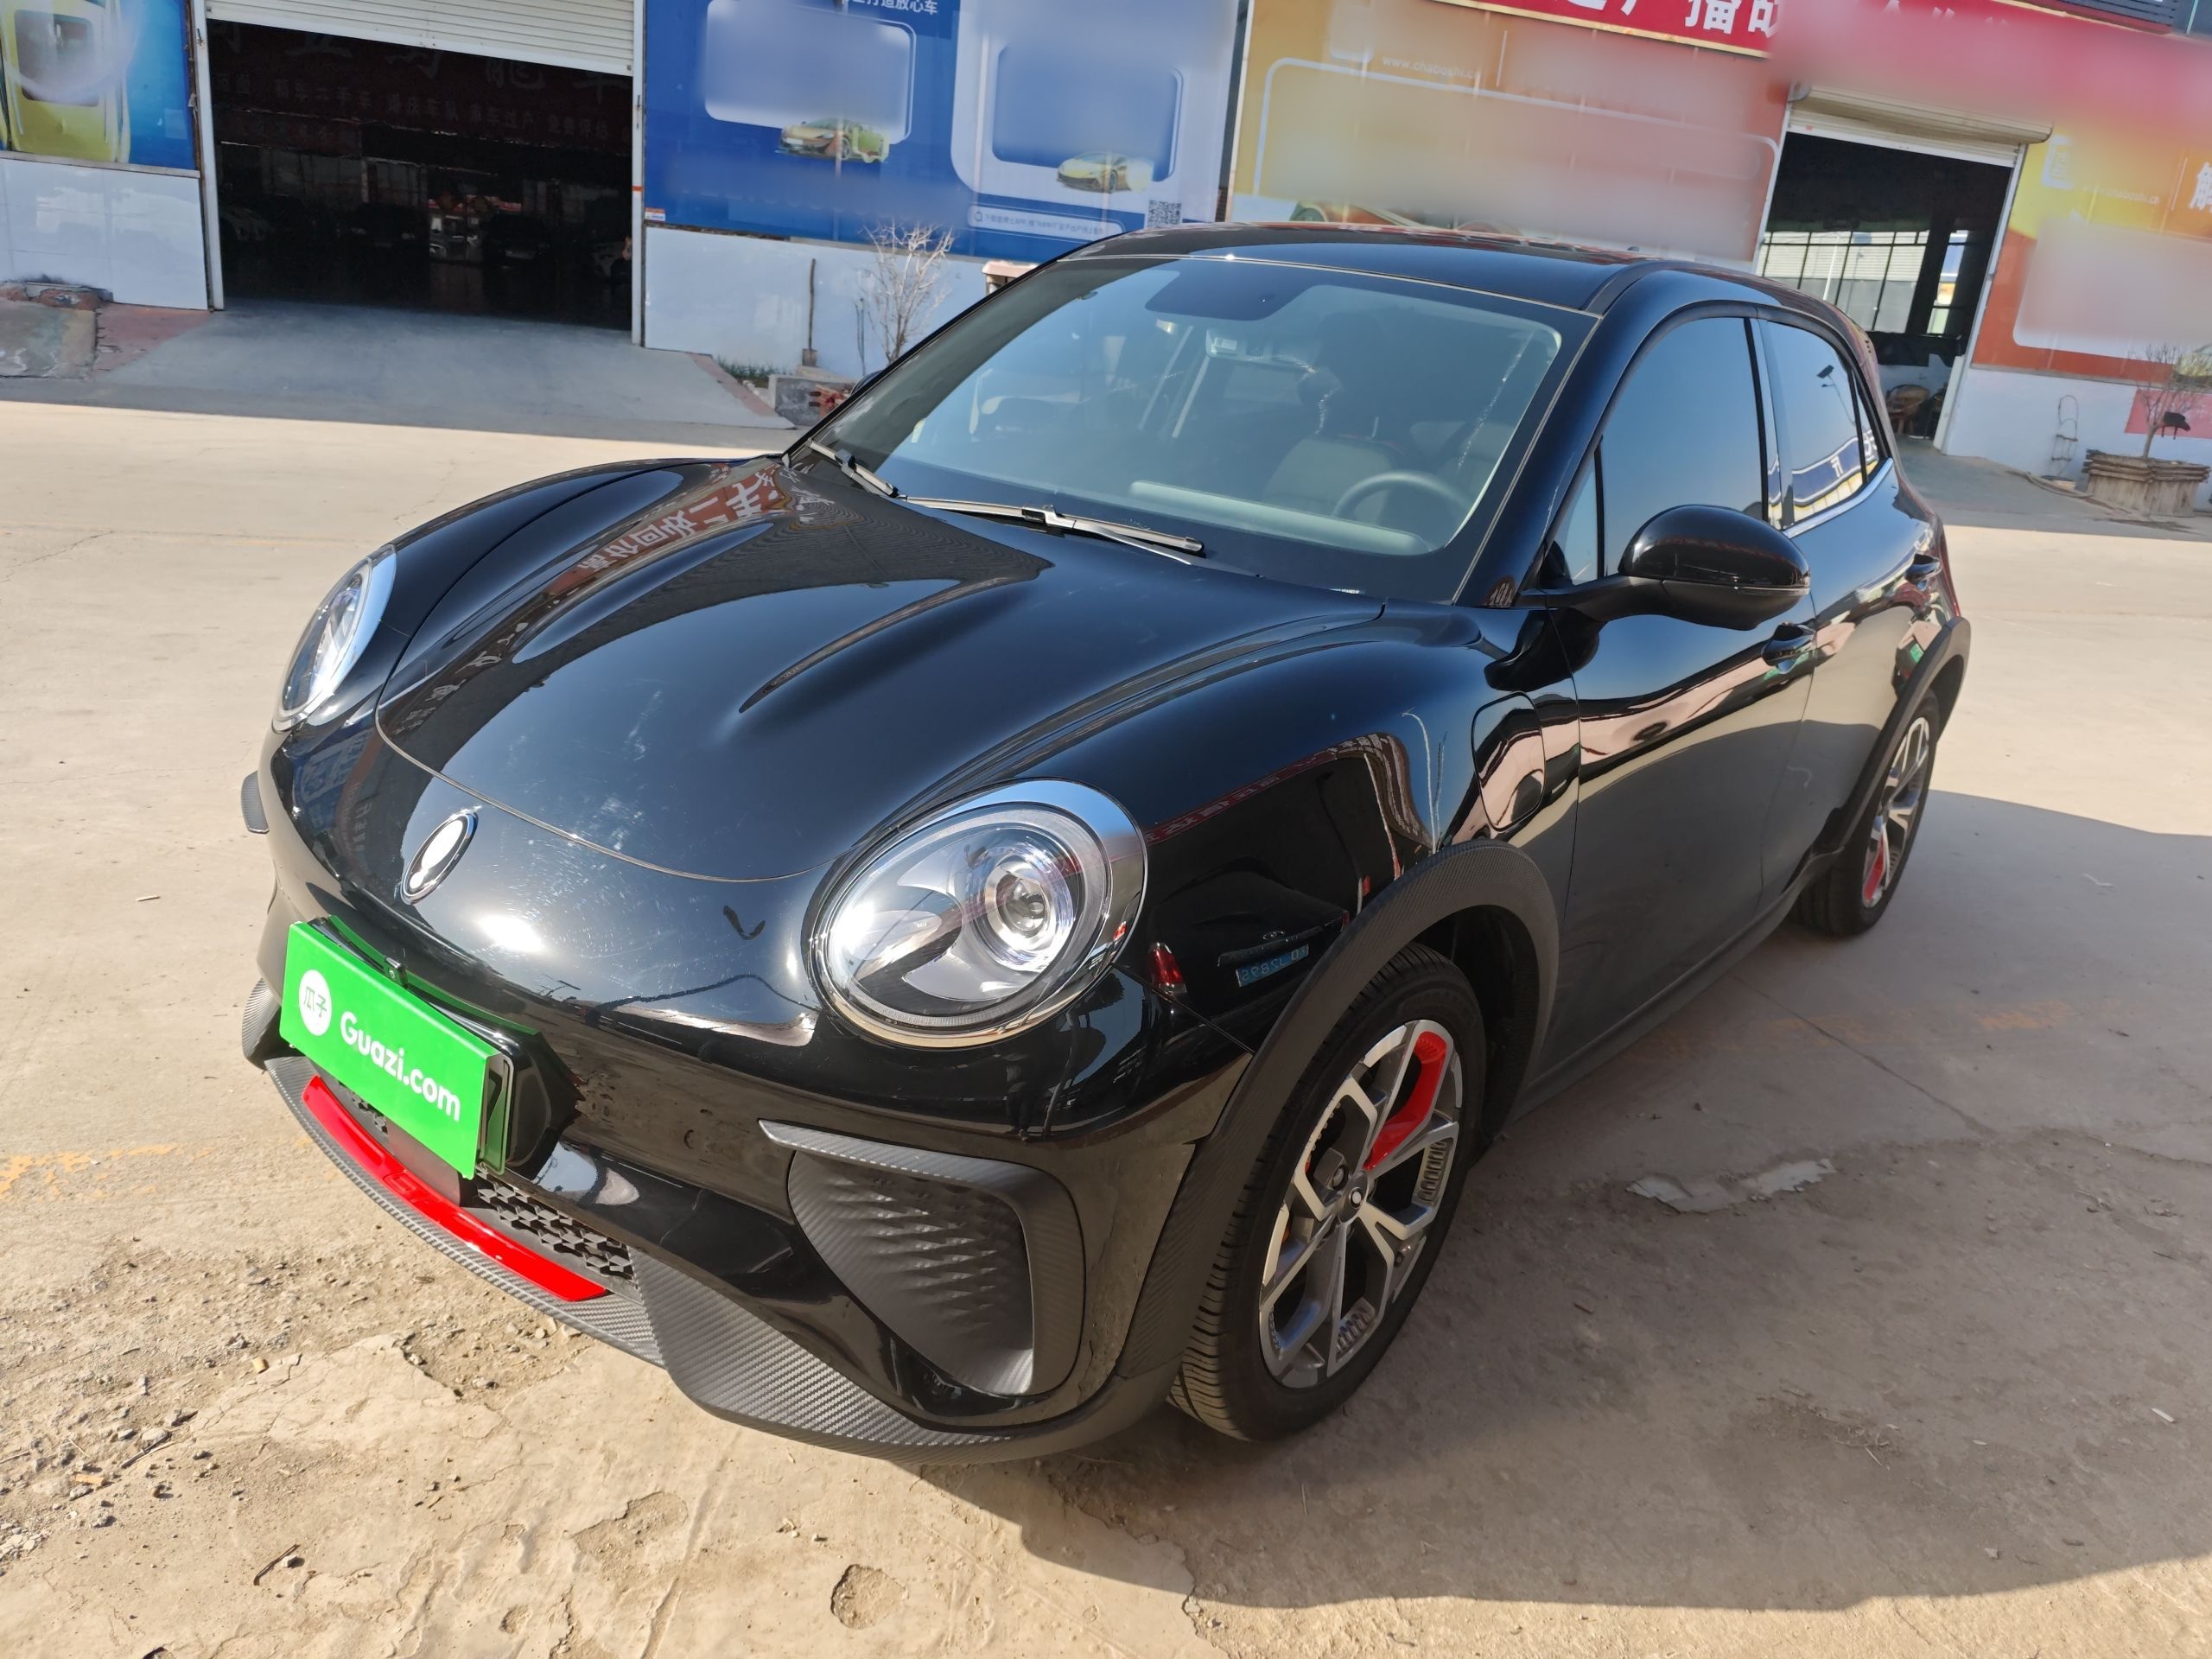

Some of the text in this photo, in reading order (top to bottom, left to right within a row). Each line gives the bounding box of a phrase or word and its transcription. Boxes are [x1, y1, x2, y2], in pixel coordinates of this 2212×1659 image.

[1382, 55, 1480, 79] www.chaboshi.c
[303, 986, 327, 1018] 瓜子
[340, 1010, 461, 1122] Guazi.com
